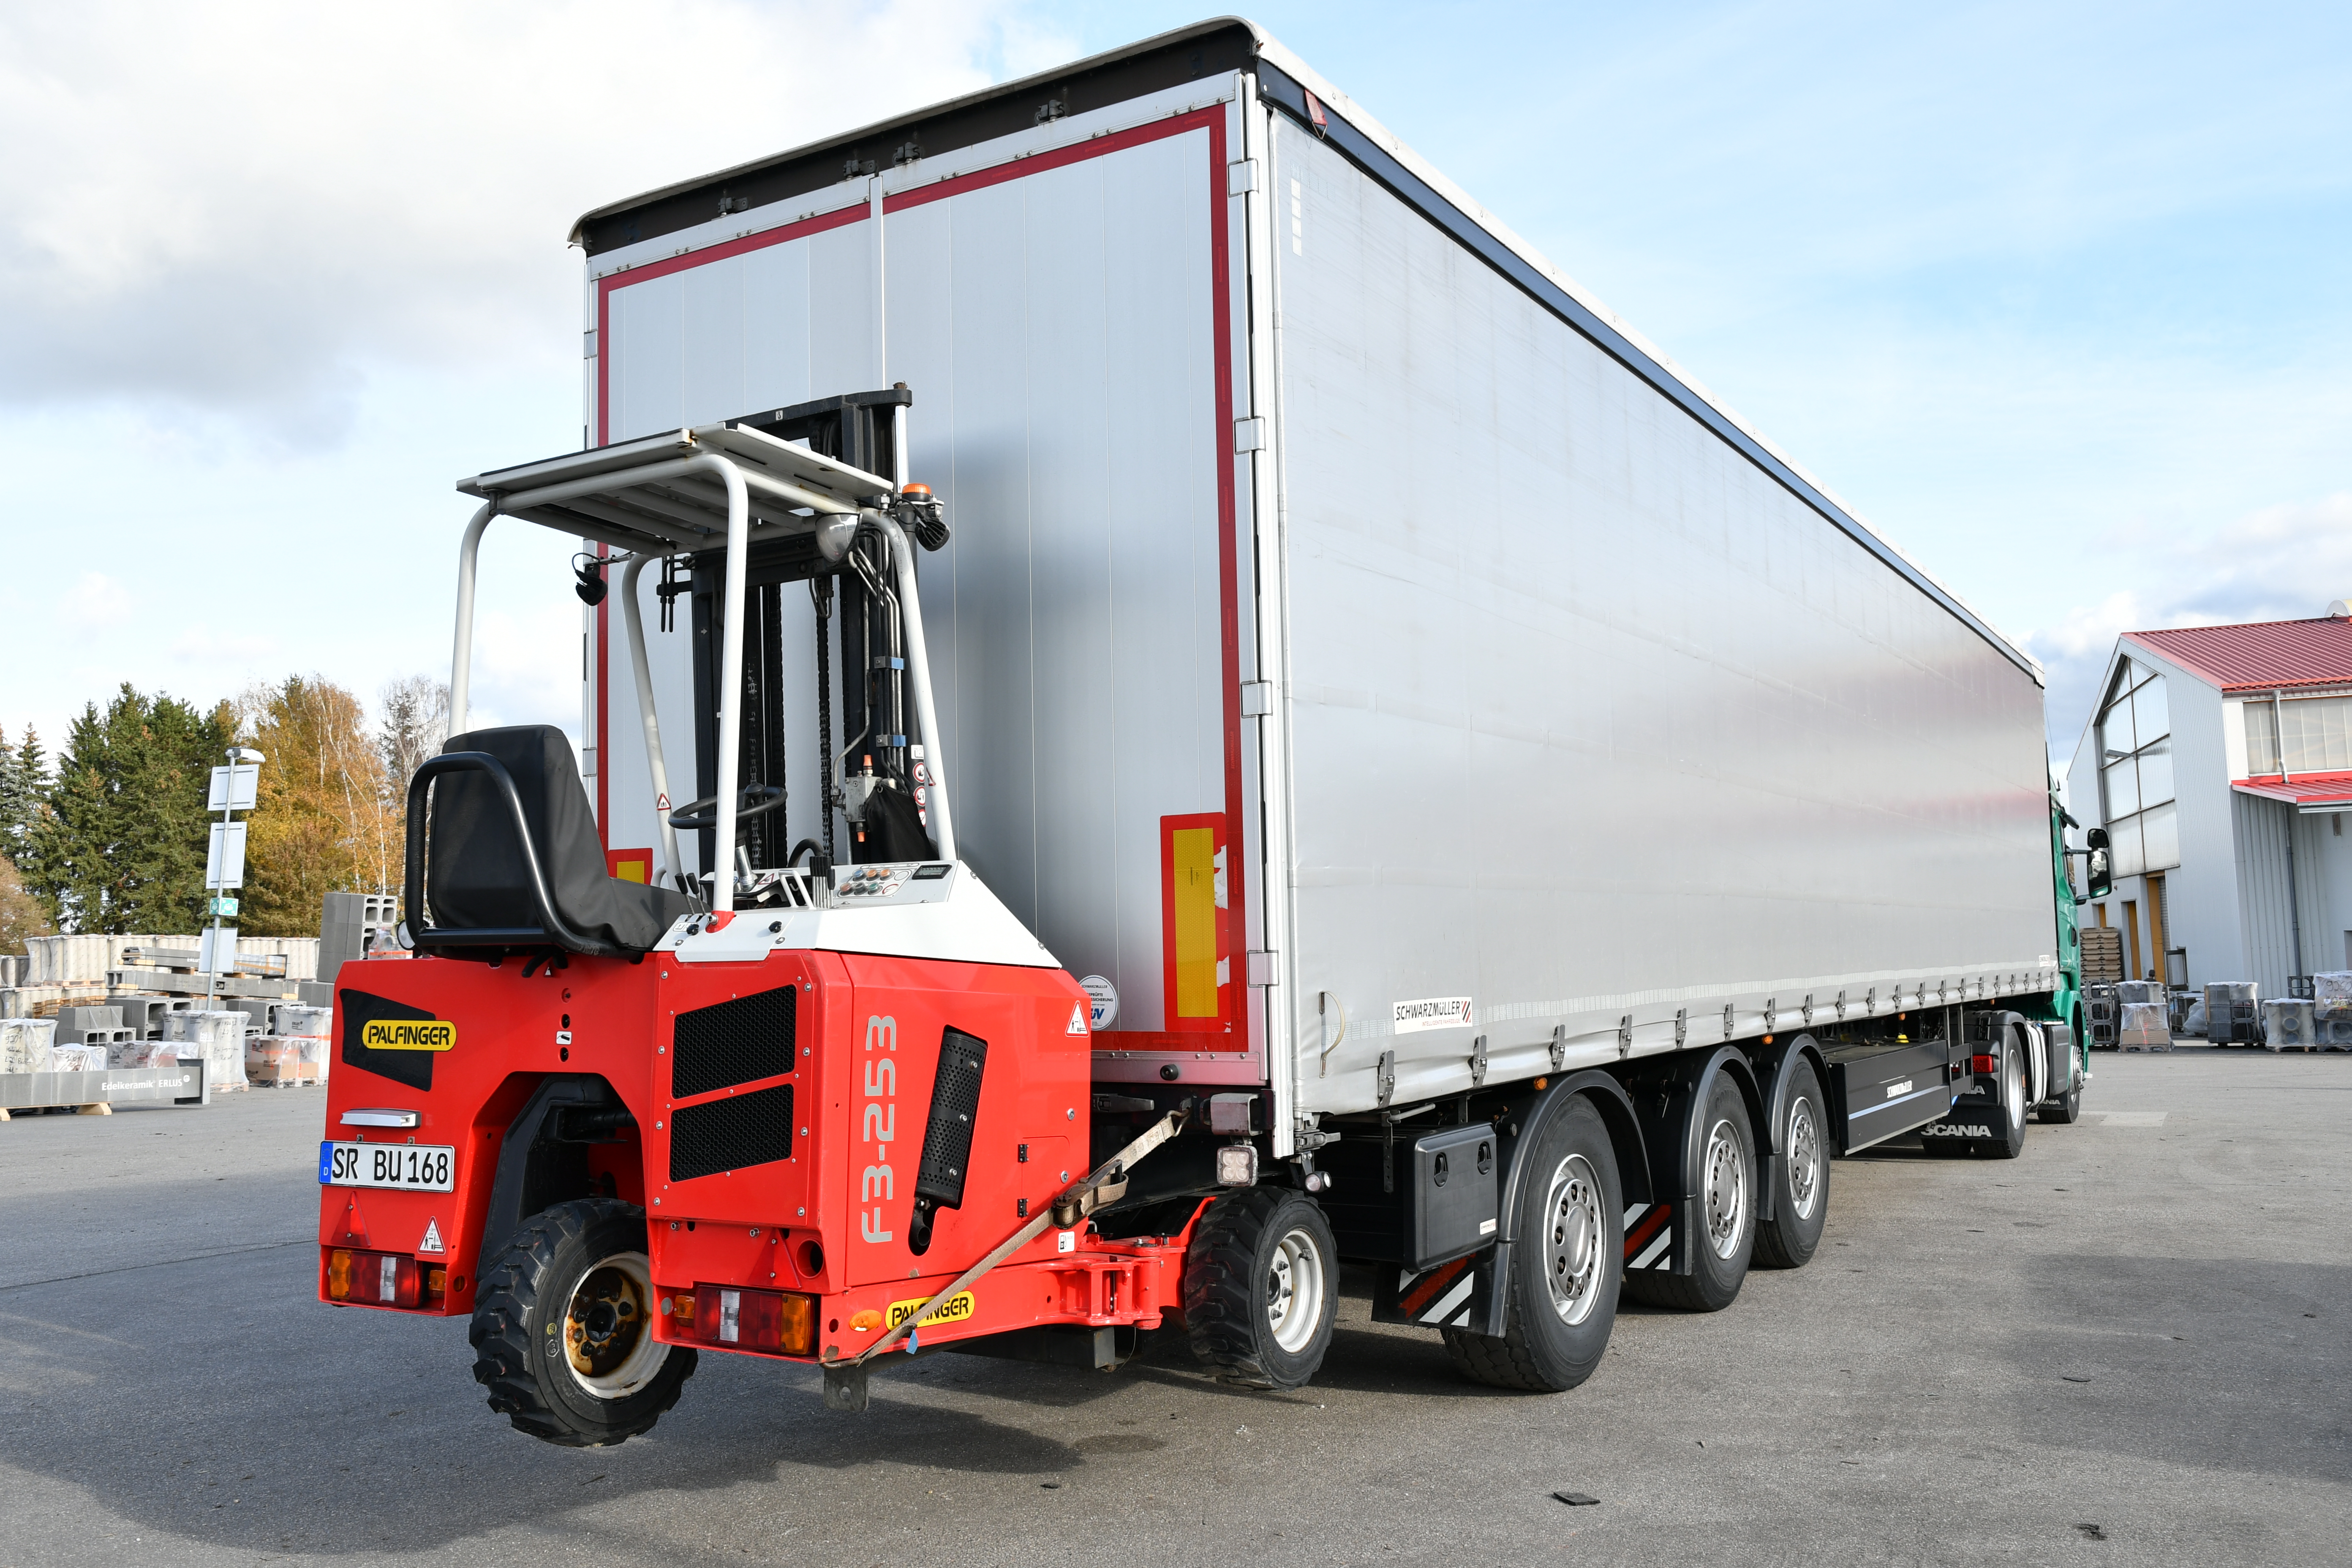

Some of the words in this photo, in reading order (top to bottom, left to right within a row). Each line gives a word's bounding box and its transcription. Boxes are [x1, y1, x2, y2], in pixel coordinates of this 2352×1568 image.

[1396, 1001, 1460, 1021] SCHWARZMÜLLER
[368, 1026, 450, 1045] PALFINGER
[102, 1081, 153, 1091] Edelkeramik
[159, 1079, 183, 1088] ERLUS
[862, 1015, 896, 1244] F3-253
[324, 1167, 329, 1176] D
[332, 1148, 358, 1179] SR
[374, 1149, 401, 1182] BU
[408, 1151, 448, 1184] 168
[892, 1297, 969, 1326] PALNGER
